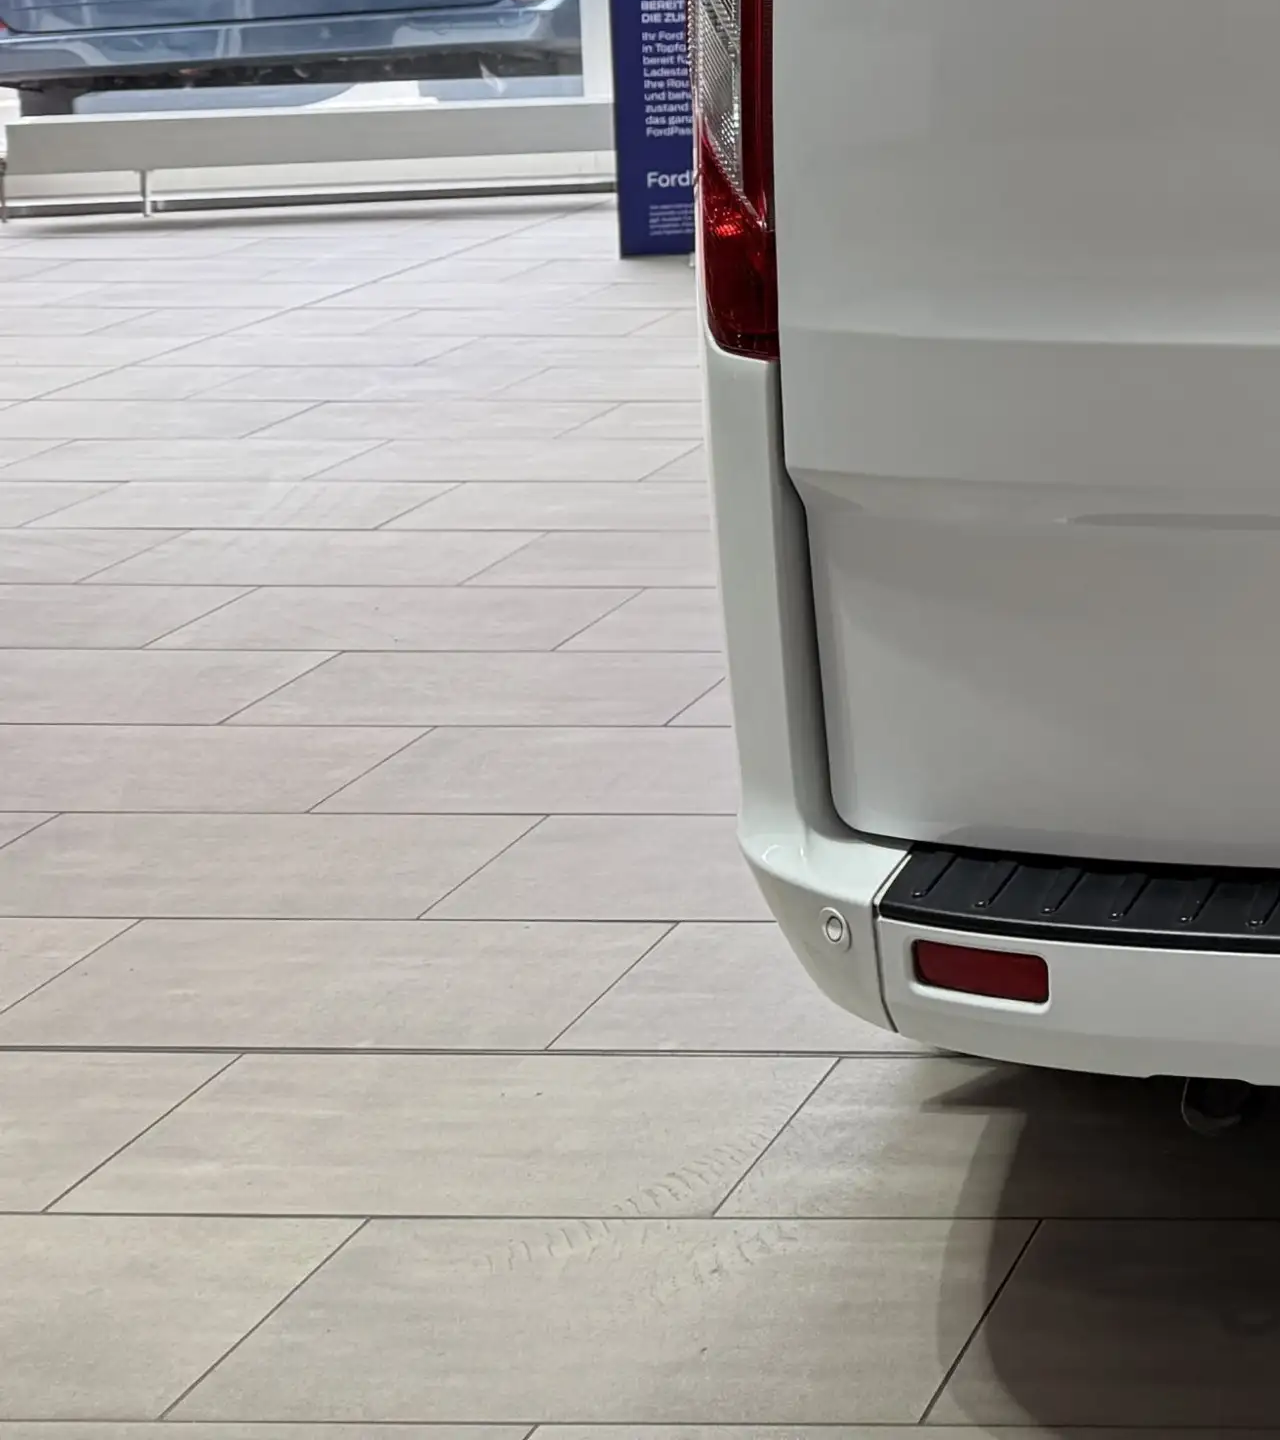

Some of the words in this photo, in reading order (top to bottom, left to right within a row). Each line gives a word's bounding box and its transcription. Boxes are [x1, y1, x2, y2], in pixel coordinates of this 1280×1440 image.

[641, 0, 685, 11] BEREIT
[641, 13, 662, 23] DIE
[642, 32, 656, 41] Ihr
[658, 30, 685, 41] Ford
[642, 43, 653, 53] in
[655, 42, 687, 54] Topfo
[642, 55, 675, 65] bereit
[643, 67, 689, 78] Ladesta
[643, 79, 665, 89] Ihre
[666, 79, 690, 89] Rou
[644, 91, 666, 101] und
[645, 103, 690, 114] zustand
[645, 115, 666, 125] das
[646, 126, 693, 137] FordPas
[646, 169, 694, 189] Ford
